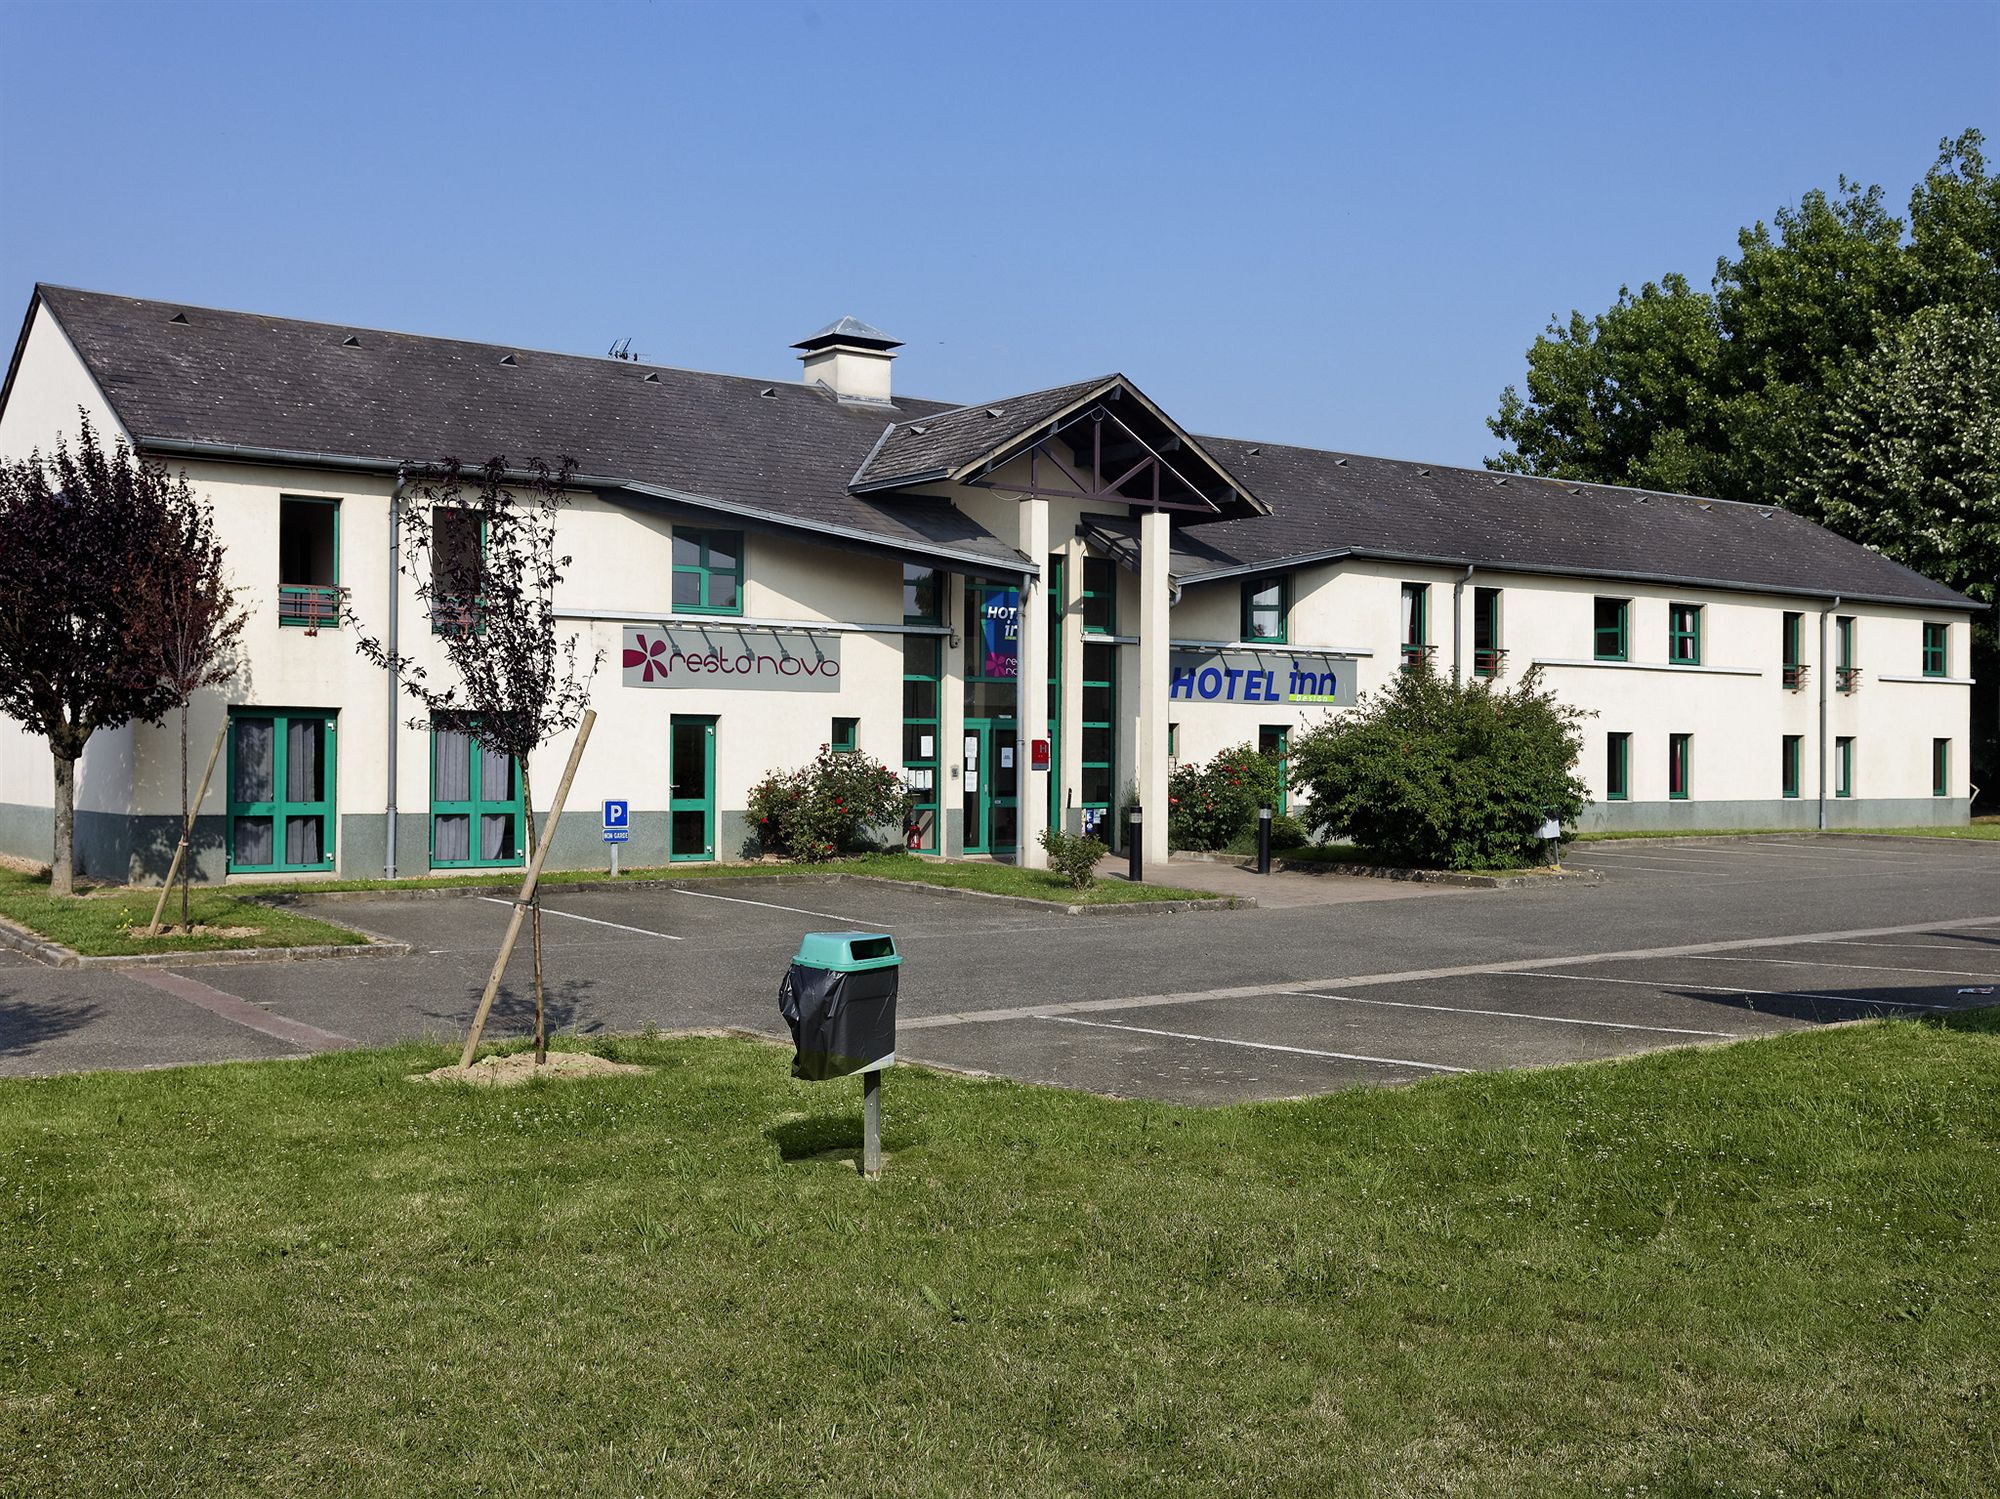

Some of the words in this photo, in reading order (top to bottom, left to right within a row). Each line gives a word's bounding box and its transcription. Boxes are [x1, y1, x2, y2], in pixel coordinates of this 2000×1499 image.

[987, 606, 1018, 620] HOT
[1170, 667, 1280, 702] HOTEL
[1289, 661, 1337, 695] inn
[610, 805, 622, 823] P
